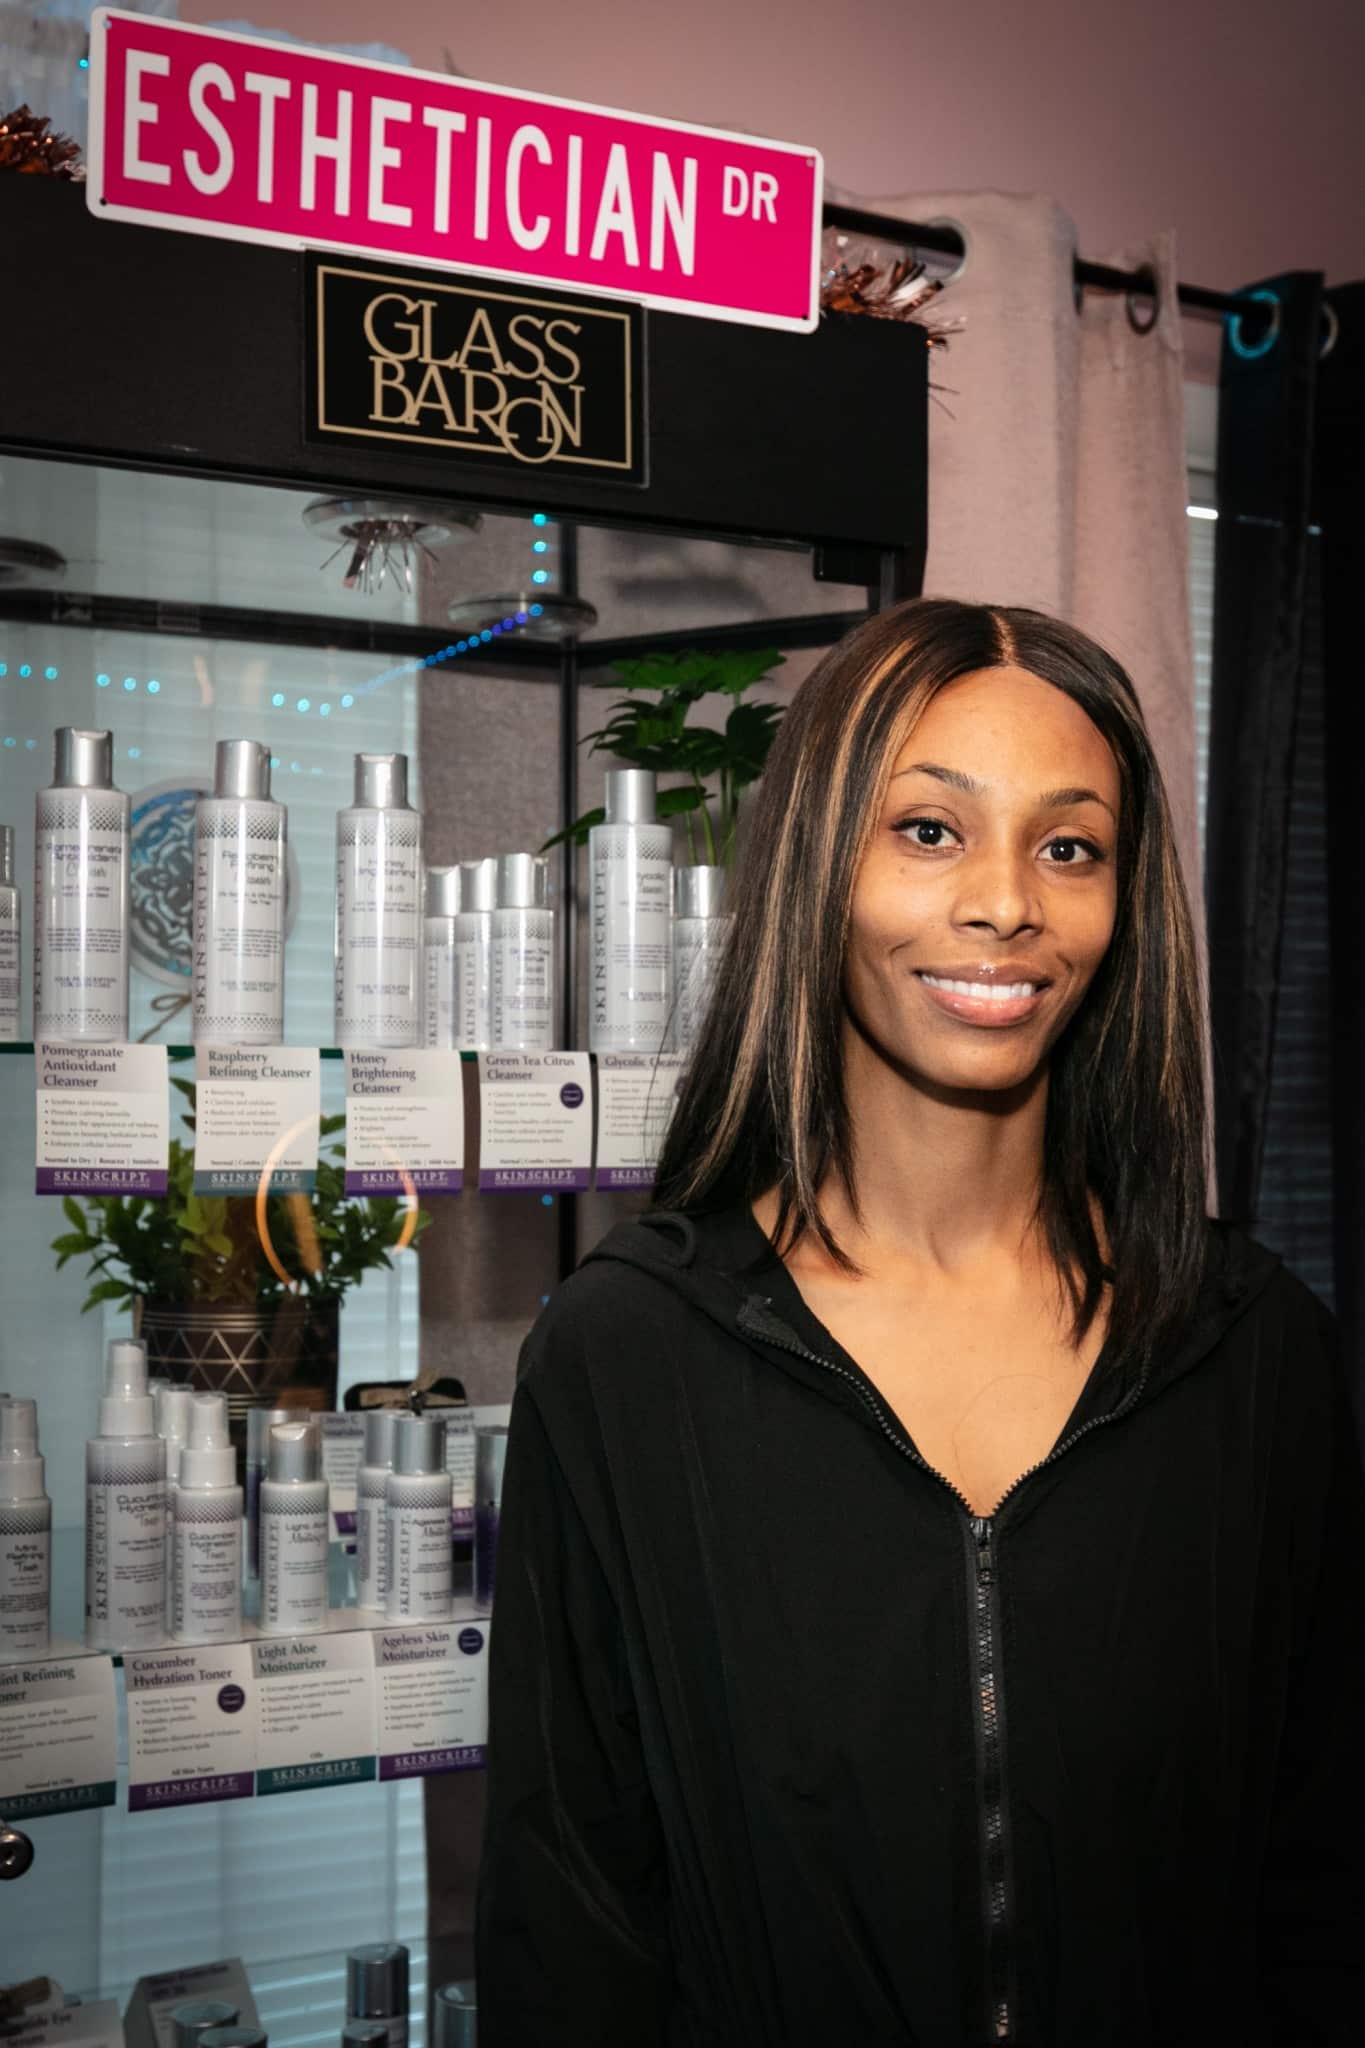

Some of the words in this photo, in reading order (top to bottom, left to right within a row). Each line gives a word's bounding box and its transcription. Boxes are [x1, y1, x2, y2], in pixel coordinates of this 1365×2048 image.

[123, 48, 698, 276] ESTHETICIAN
[722, 166, 779, 224] DR
[363, 292, 582, 385] GLASS
[369, 356, 585, 463] BARON
[42, 1045, 124, 1059] Pomegranate
[209, 1050, 268, 1063] Raspberry
[351, 1053, 387, 1065] Honey
[44, 1060, 117, 1073] Antioxidant
[486, 1055, 519, 1066] Green
[522, 1055, 541, 1066] Tea
[544, 1055, 575, 1066] Citrus
[605, 1056, 646, 1070] Glycolic
[209, 1066, 257, 1080] Refining
[261, 1067, 312, 1078] Cleanser
[352, 1068, 416, 1081] Brightening
[487, 1069, 533, 1080] Cleanser
[43, 1075, 98, 1087] Cleanser
[353, 1083, 401, 1094] Cleanser
[211, 1172, 297, 1183] SKINSCIPT
[381, 1633, 423, 1648] Ageless
[426, 1631, 450, 1642] Skin
[257, 1645, 287, 1659] Light
[291, 1643, 317, 1655] Aloe
[382, 1648, 447, 1662] Moisturizer
[132, 1656, 196, 1671] Cucumber
[259, 1659, 327, 1674] Moisturizer
[0, 1673, 18, 1685] int
[22, 1667, 76, 1683] Refining
[134, 1672, 195, 1688] Hydration
[199, 1669, 232, 1681] Toner
